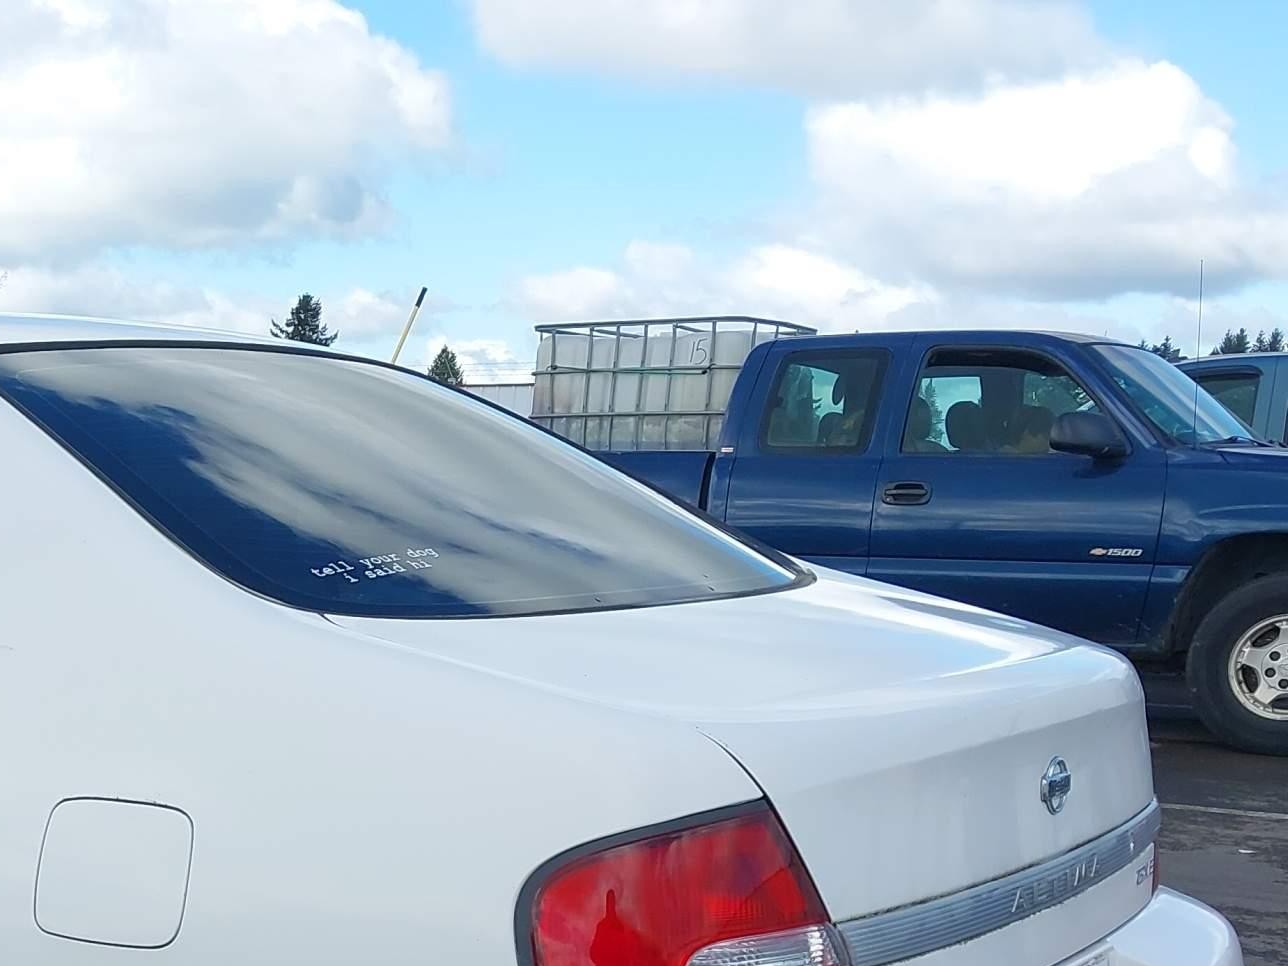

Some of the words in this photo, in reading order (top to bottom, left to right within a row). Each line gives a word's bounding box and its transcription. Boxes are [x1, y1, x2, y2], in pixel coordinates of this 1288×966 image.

[690, 337, 708, 365] 15
[310, 561, 354, 578] tell
[359, 552, 402, 569] your
[406, 547, 440, 559] dog
[1107, 548, 1144, 557] 1500
[343, 573, 359, 584] i
[364, 562, 407, 579] said
[407, 559, 433, 570] hi
